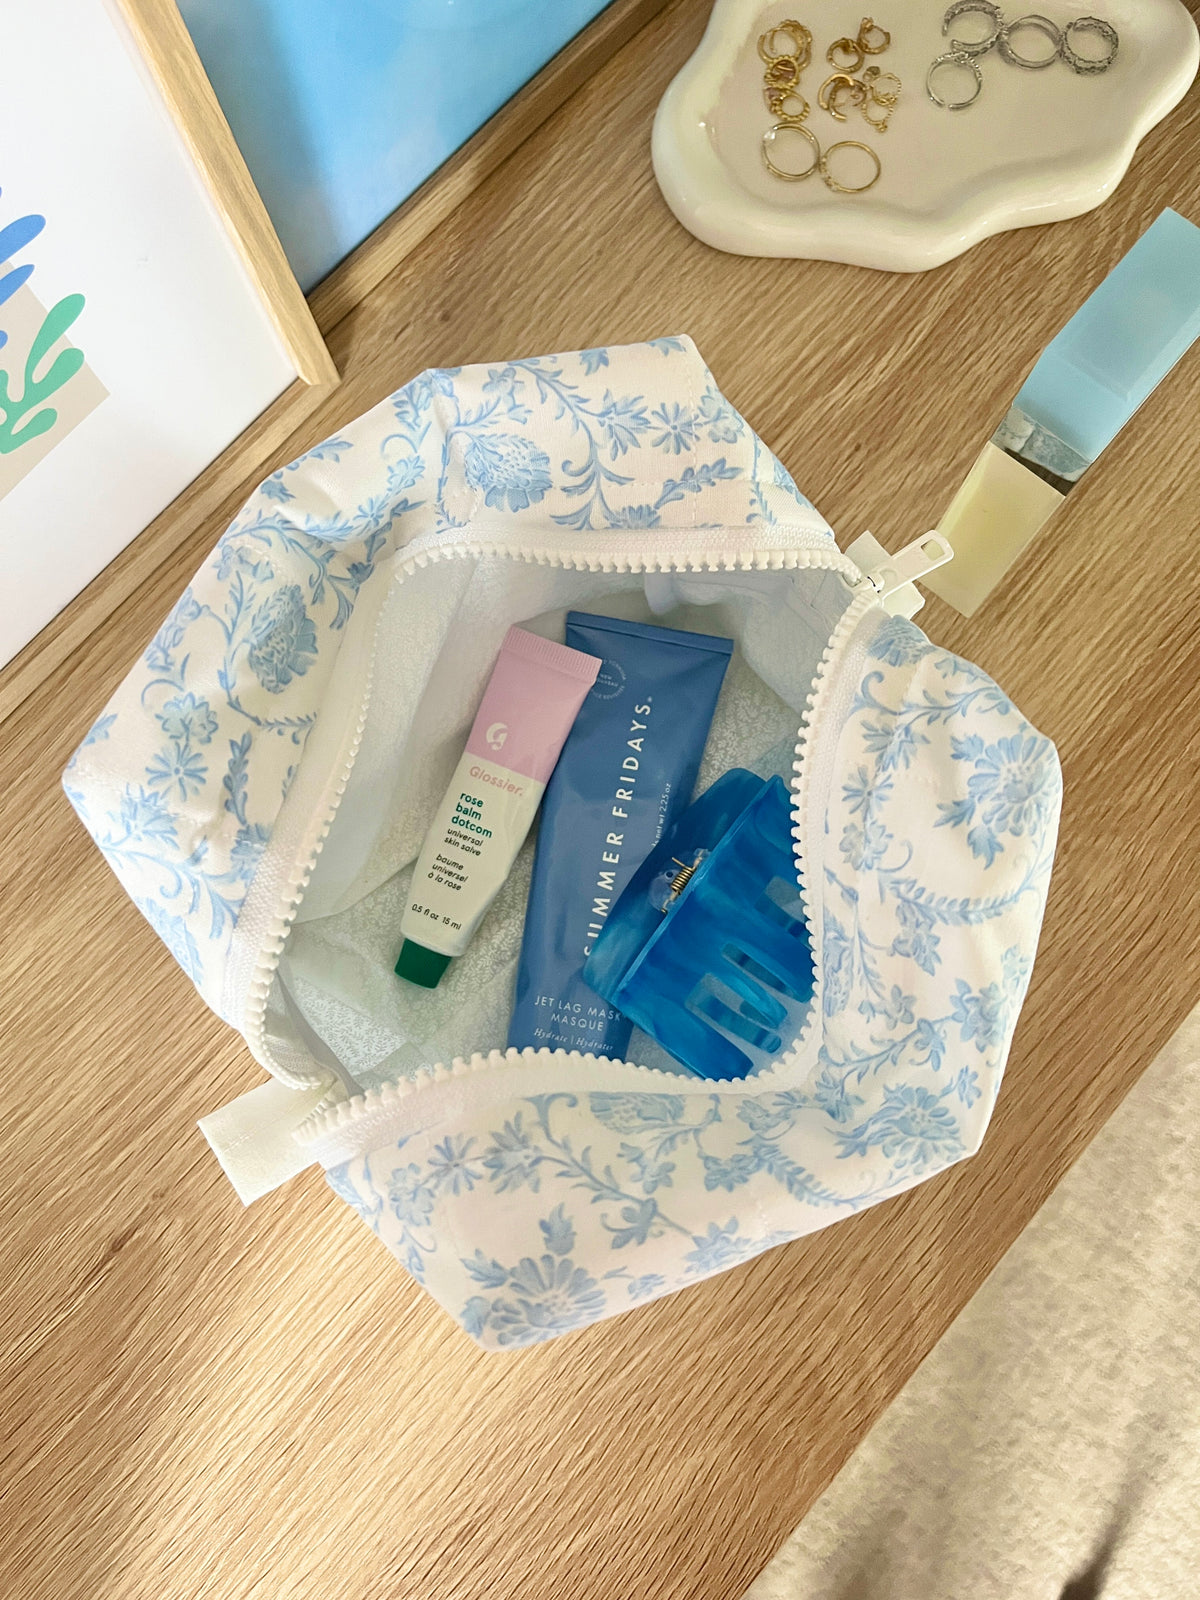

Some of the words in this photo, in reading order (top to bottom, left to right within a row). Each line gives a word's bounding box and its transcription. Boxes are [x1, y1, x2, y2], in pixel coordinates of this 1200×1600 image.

[469, 765, 523, 797] Glossier.
[460, 793, 484, 807] rose
[456, 802, 482, 820] balm
[451, 815, 493, 838] dotcom
[444, 837, 460, 848] skin
[461, 843, 481, 856] salve
[447, 828, 484, 847] universal
[436, 854, 464, 870] baume
[432, 863, 469, 882] universel
[434, 874, 444, 883] la
[444, 879, 462, 891] rose
[423, 908, 430, 916] fl
[430, 912, 439, 920] oz
[442, 916, 451, 925] 15
[450, 922, 462, 930] ml
[534, 995, 555, 1007] JET
[558, 1000, 582, 1013] LAG
[587, 1007, 621, 1022] MASK
[551, 1013, 604, 1032] MASQUE
[534, 1027, 568, 1043] Hydrate
